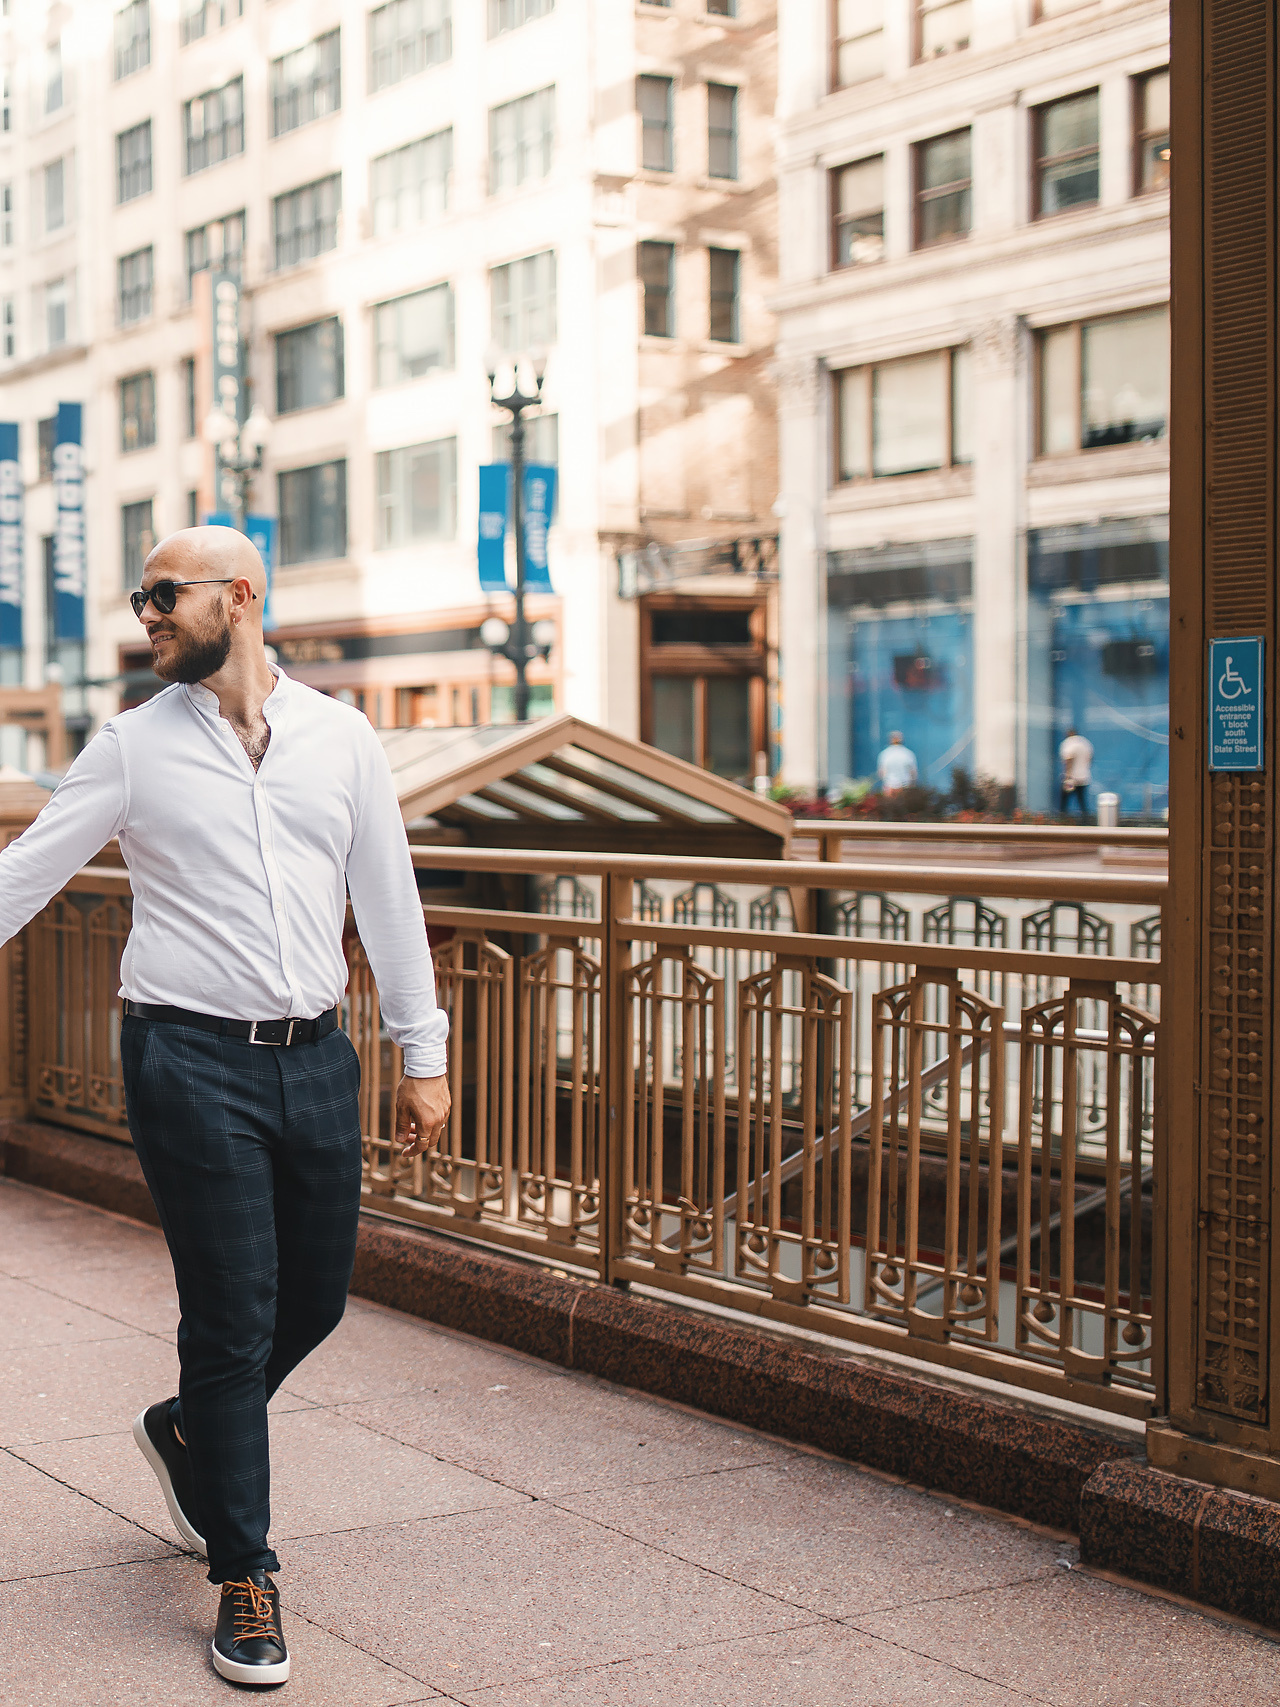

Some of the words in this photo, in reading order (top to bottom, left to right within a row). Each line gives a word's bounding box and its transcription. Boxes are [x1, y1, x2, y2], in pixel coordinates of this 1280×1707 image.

[1215, 704, 1256, 712] Accessible
[1224, 729, 1246, 737] south
[1214, 745, 1233, 753] State
[1234, 745, 1257, 753] Street
